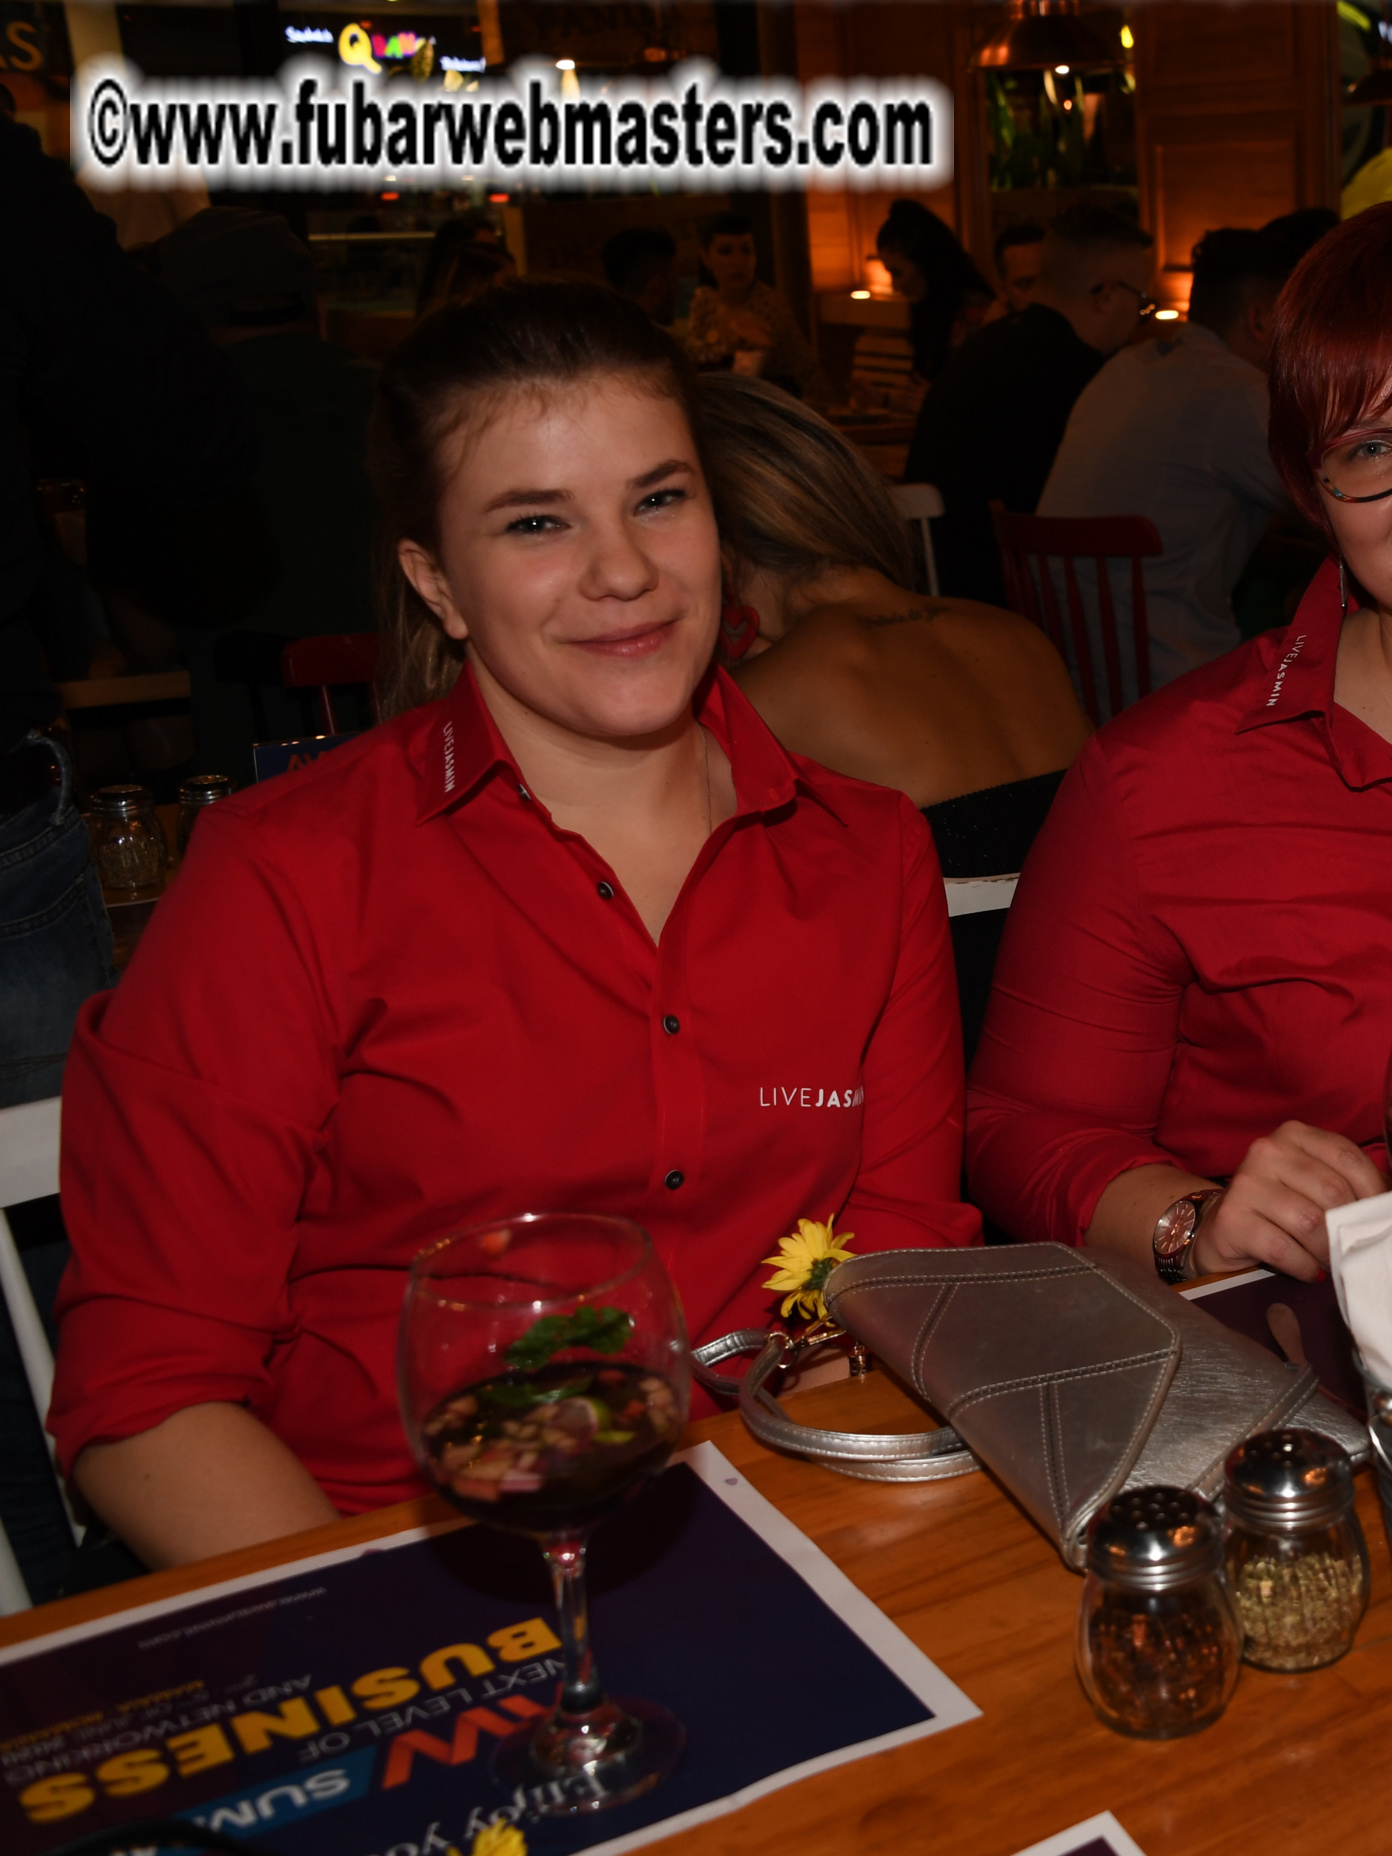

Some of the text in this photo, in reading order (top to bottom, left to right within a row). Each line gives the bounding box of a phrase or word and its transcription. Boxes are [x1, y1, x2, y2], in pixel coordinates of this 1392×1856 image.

[1266, 635, 1307, 706] LIVEJASMIN
[18, 1616, 563, 1824] BUSINESS
[242, 1673, 312, 1708] AND
[299, 1657, 566, 1765] NEXT LEVEL OF
[463, 1774, 611, 1841] Enjoy
